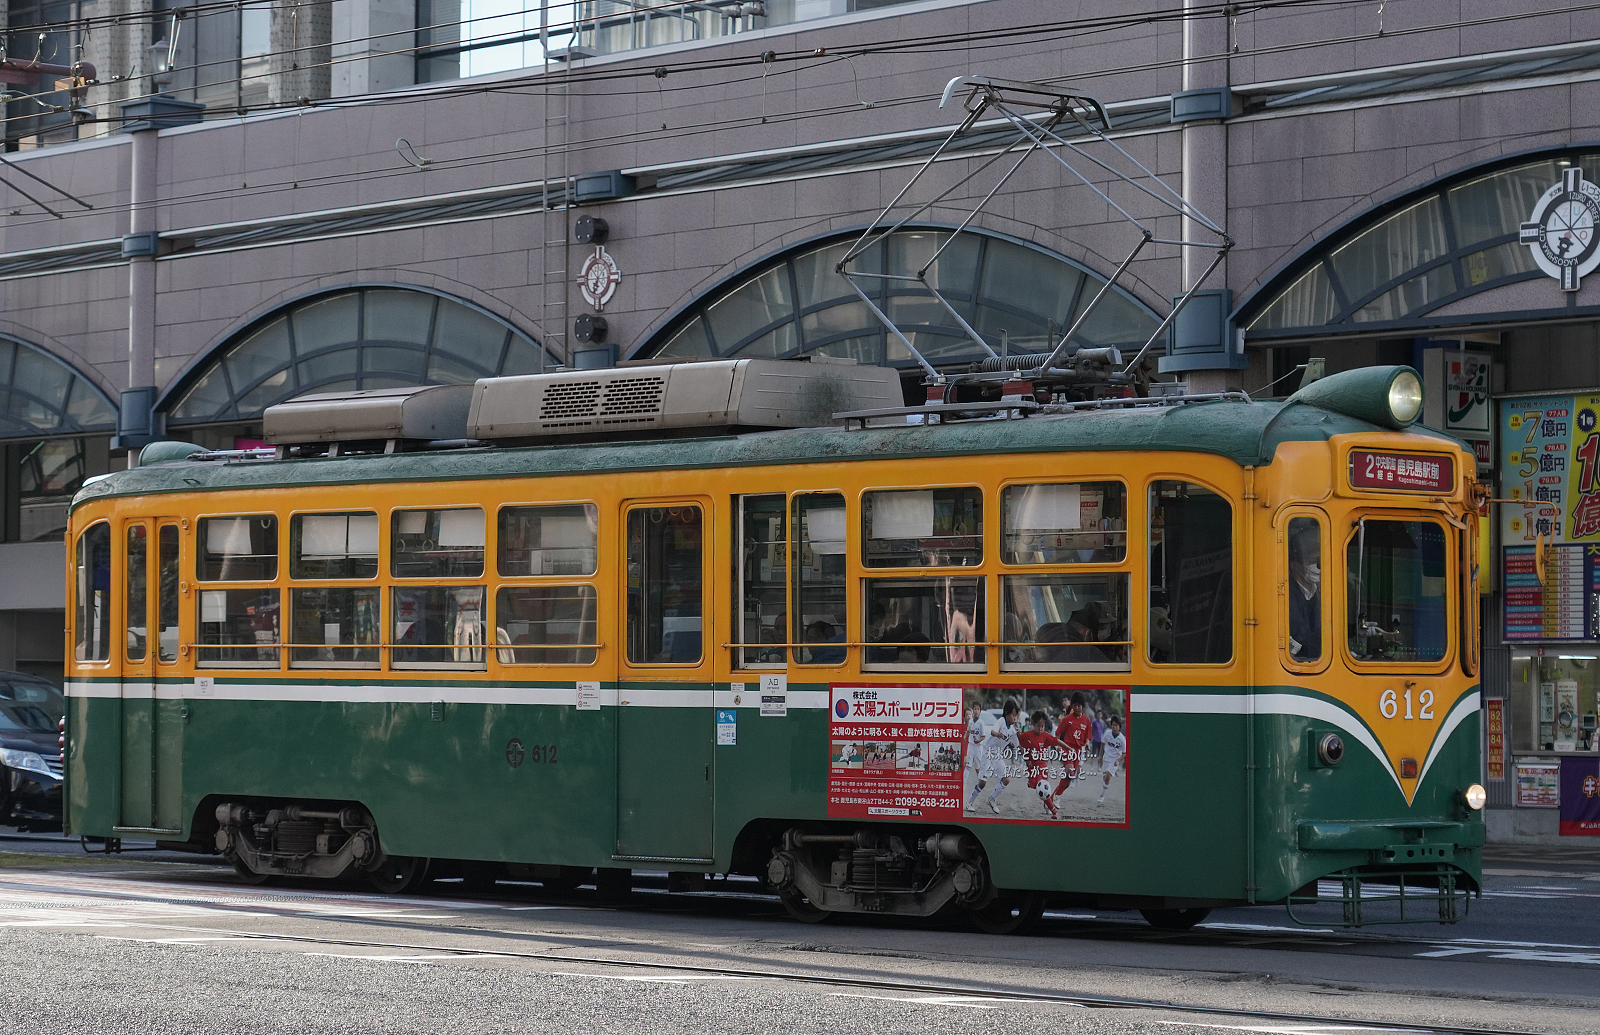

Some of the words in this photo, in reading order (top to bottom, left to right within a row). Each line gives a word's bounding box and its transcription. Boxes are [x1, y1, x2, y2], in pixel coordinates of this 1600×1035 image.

[1586, 201, 1600, 224] STREET
[1476, 444, 1490, 459] ATM
[1365, 454, 1375, 479] 2
[1375, 456, 1397, 471] 中央駅前
[1397, 458, 1445, 480] 鹿児島駅前
[767, 678, 779, 686] 入口
[852, 690, 878, 700] 株式会社
[852, 701, 960, 718] 太陽スポーツクラブ
[1379, 689, 1434, 720] 612
[1490, 710, 1501, 721] 82
[1490, 722, 1501, 732] 83
[1490, 734, 1501, 744] 84
[532, 744, 558, 764] 612
